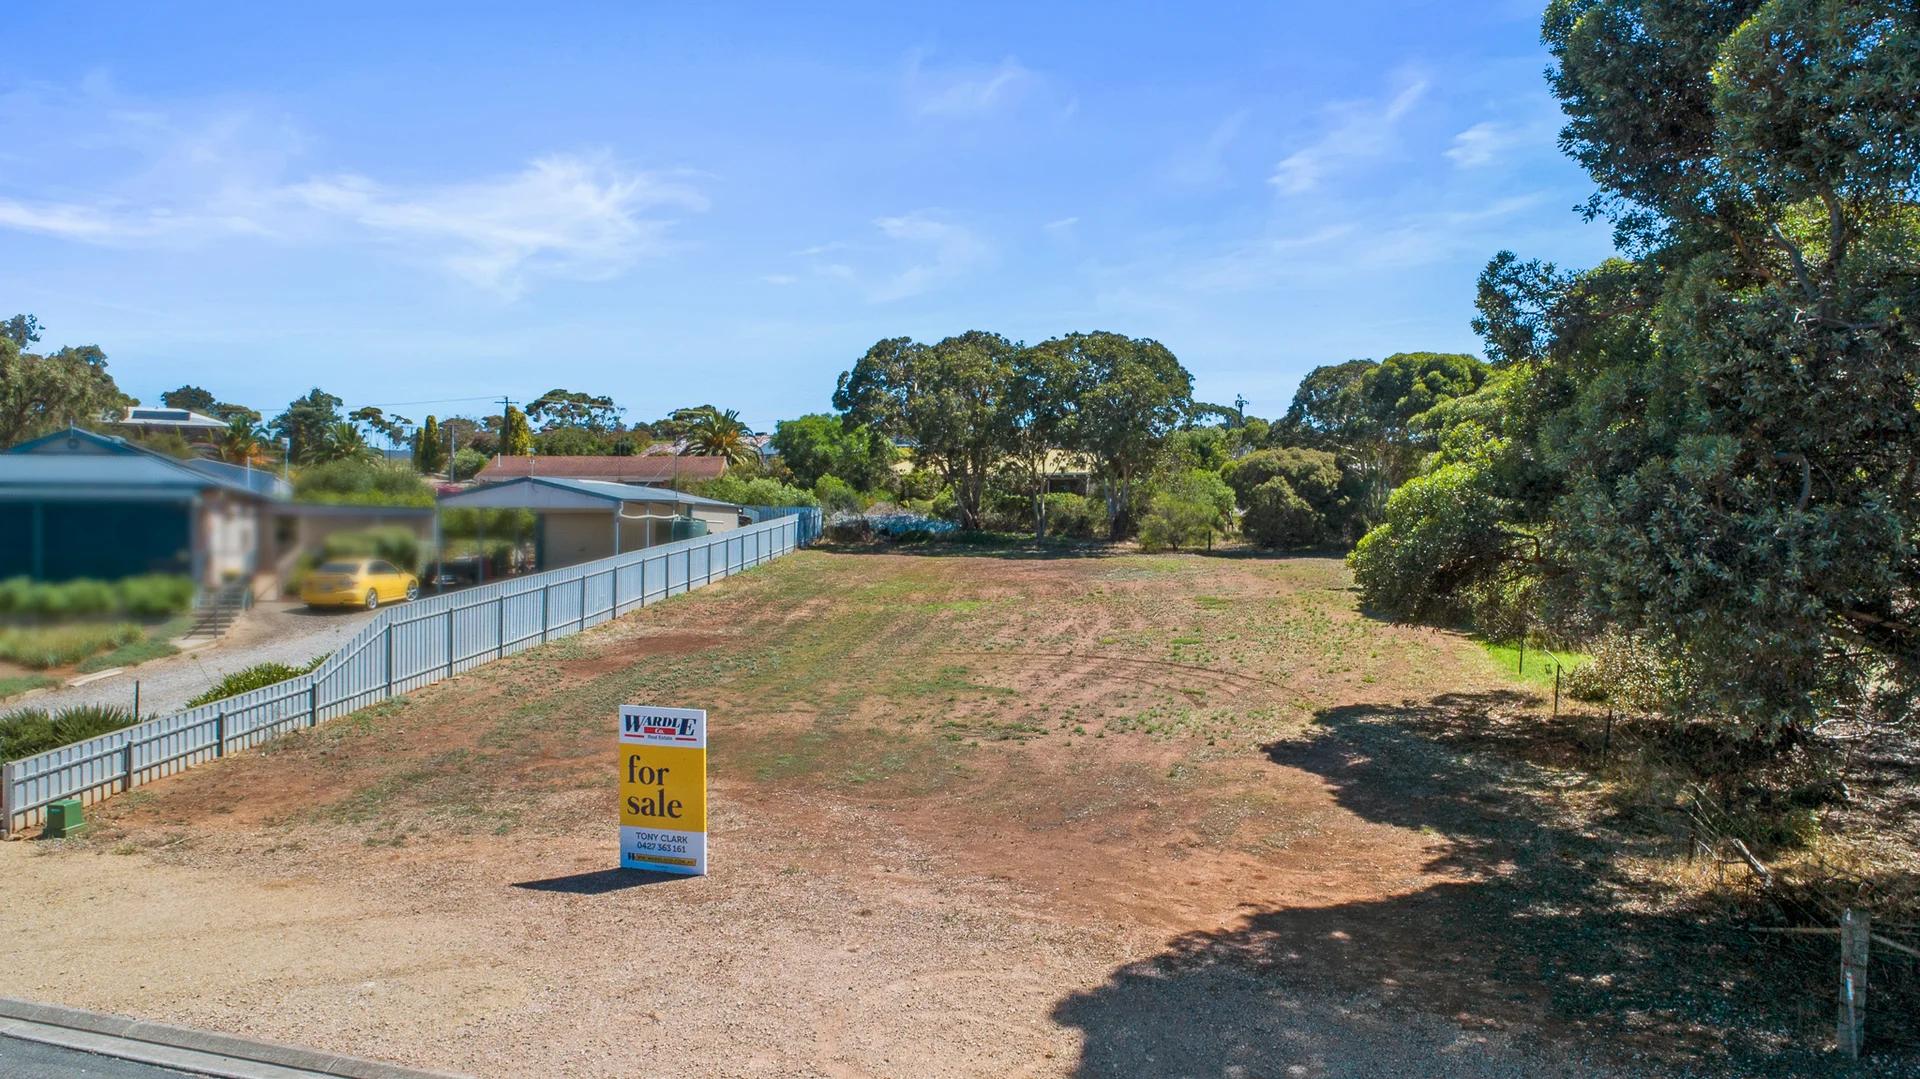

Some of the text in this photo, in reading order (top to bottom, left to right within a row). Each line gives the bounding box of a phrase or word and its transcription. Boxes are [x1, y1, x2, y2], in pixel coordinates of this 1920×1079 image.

[624, 714, 697, 736] WARDLE
[627, 754, 670, 786] for
[627, 788, 683, 818] sale
[636, 832, 688, 844] TONY CLARK
[637, 841, 686, 853] 0427 363 161
